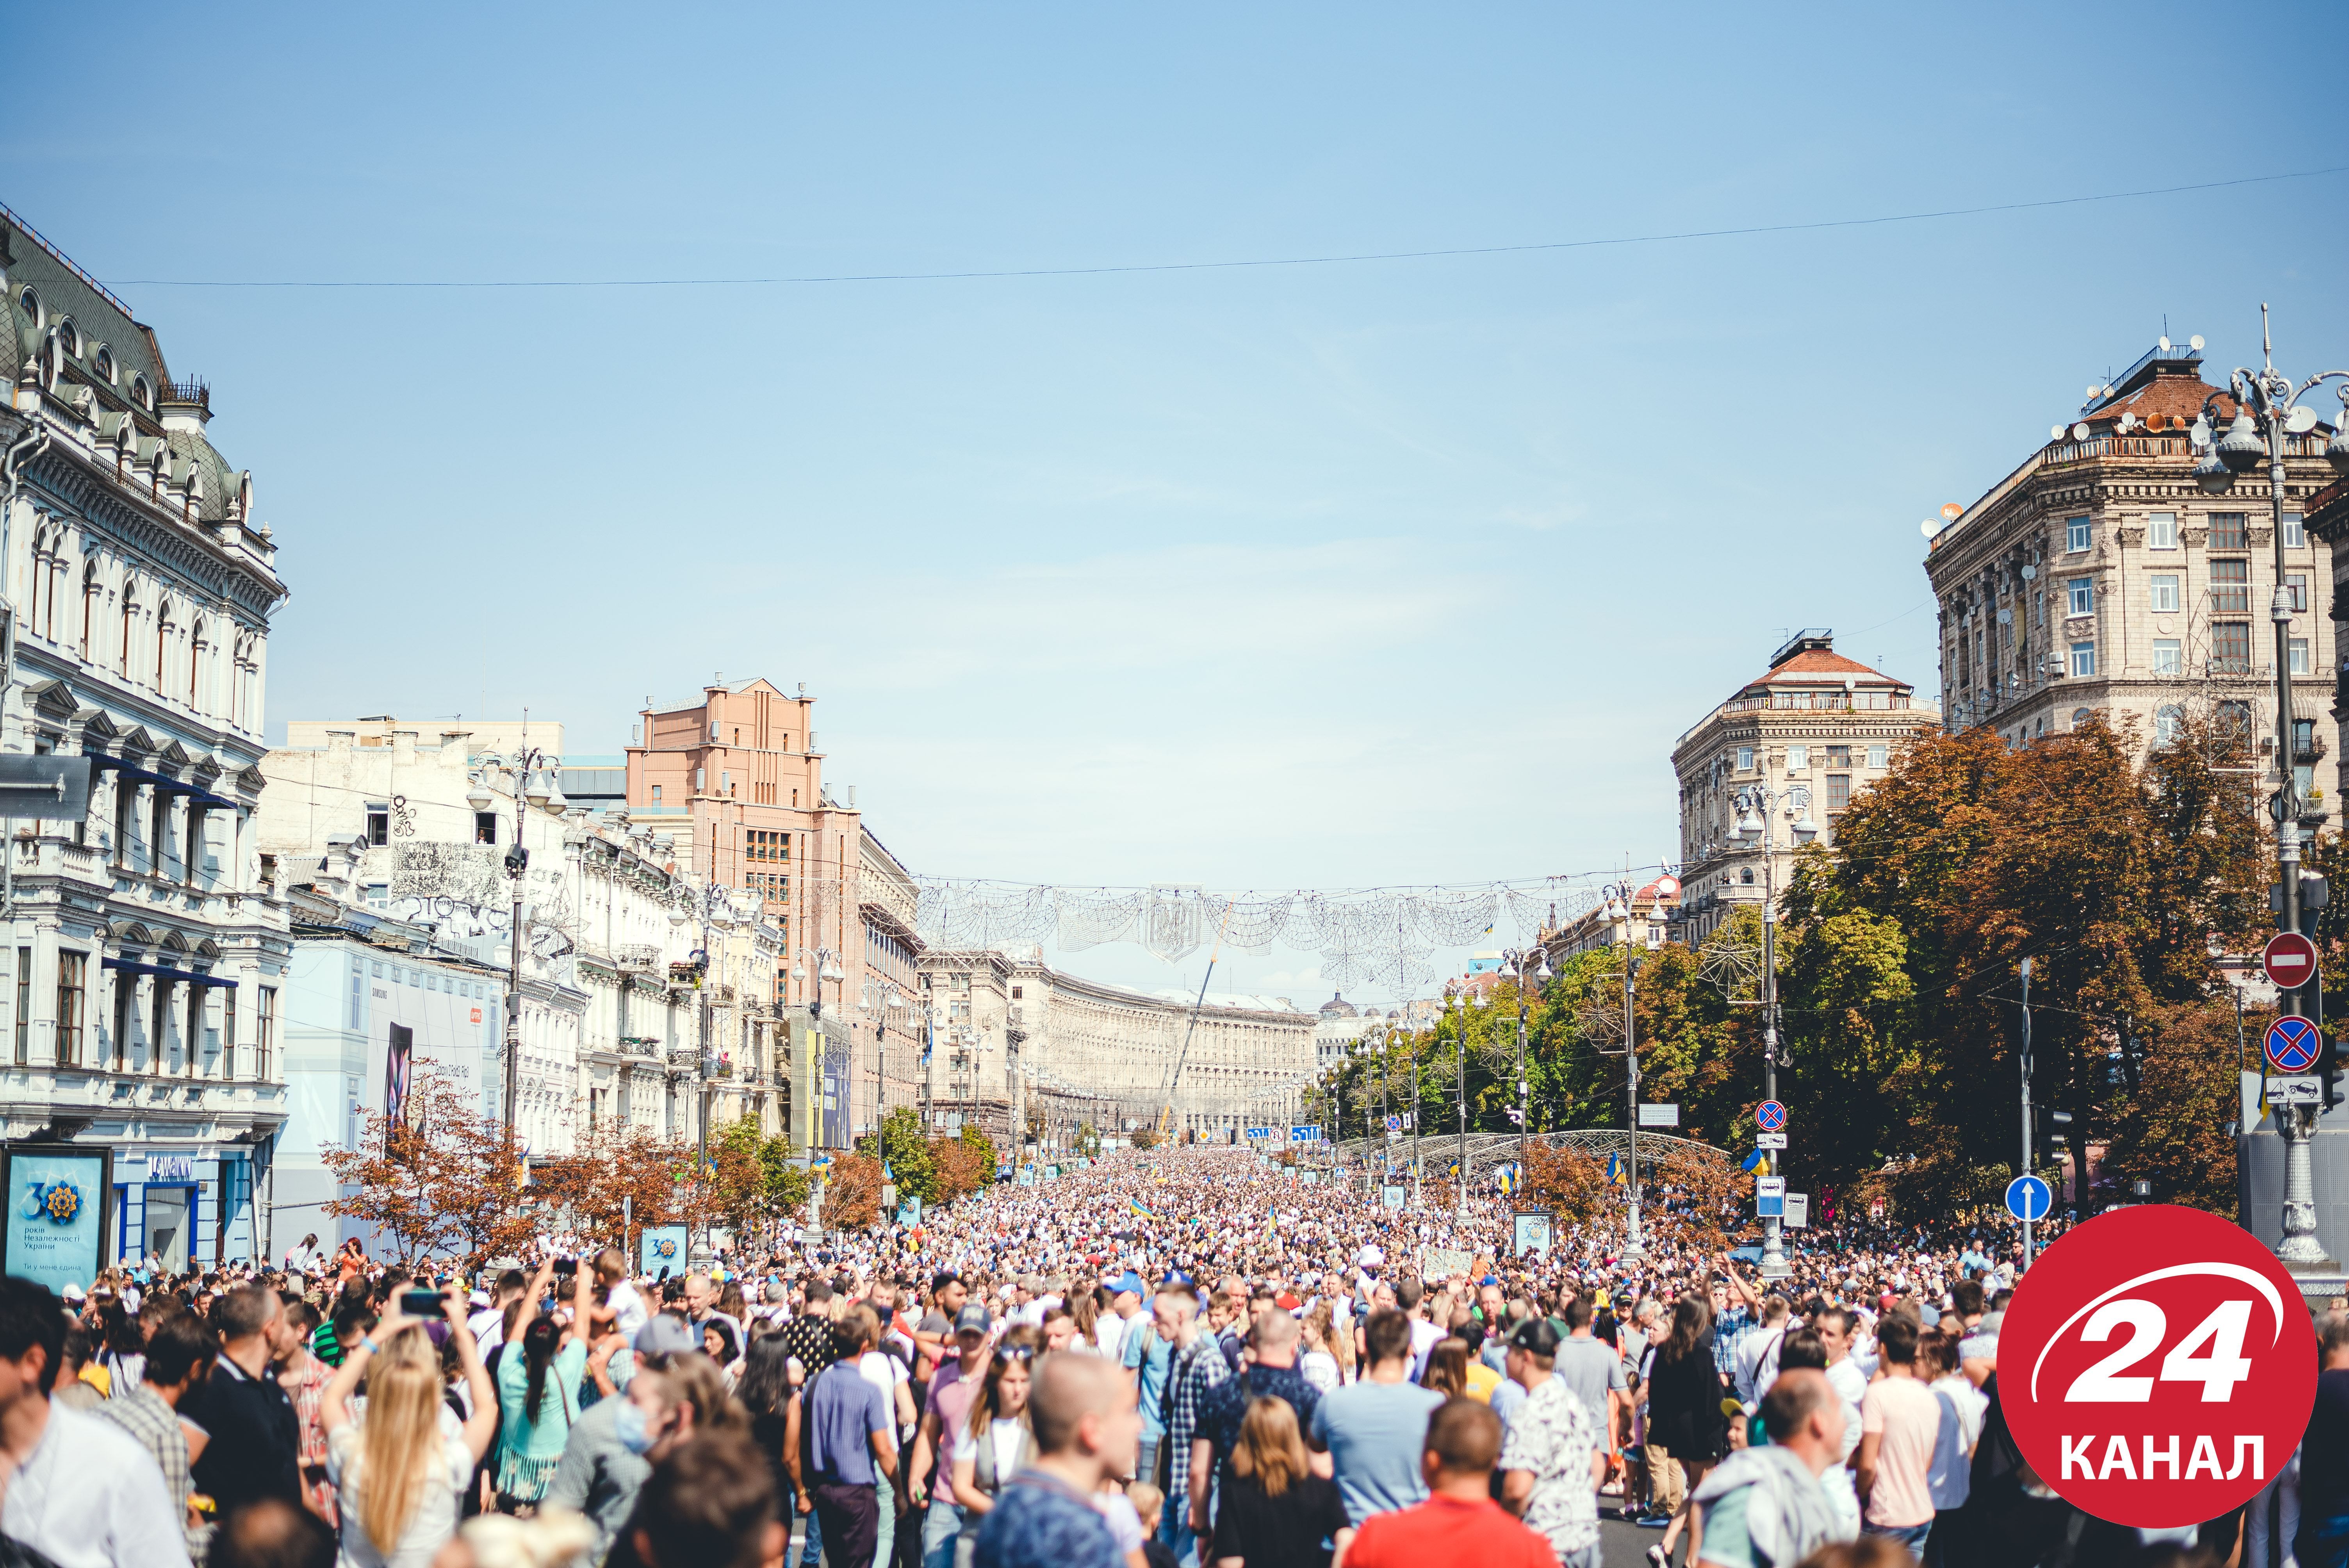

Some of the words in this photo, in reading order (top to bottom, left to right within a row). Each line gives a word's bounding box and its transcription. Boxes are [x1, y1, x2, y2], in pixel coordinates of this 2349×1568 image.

[372, 987, 387, 1000] SAMSUNG
[435, 1063, 448, 1080] Galaxy
[451, 1064, 460, 1077] Fold3
[25, 1226, 45, 1235] років
[24, 1242, 55, 1251] України
